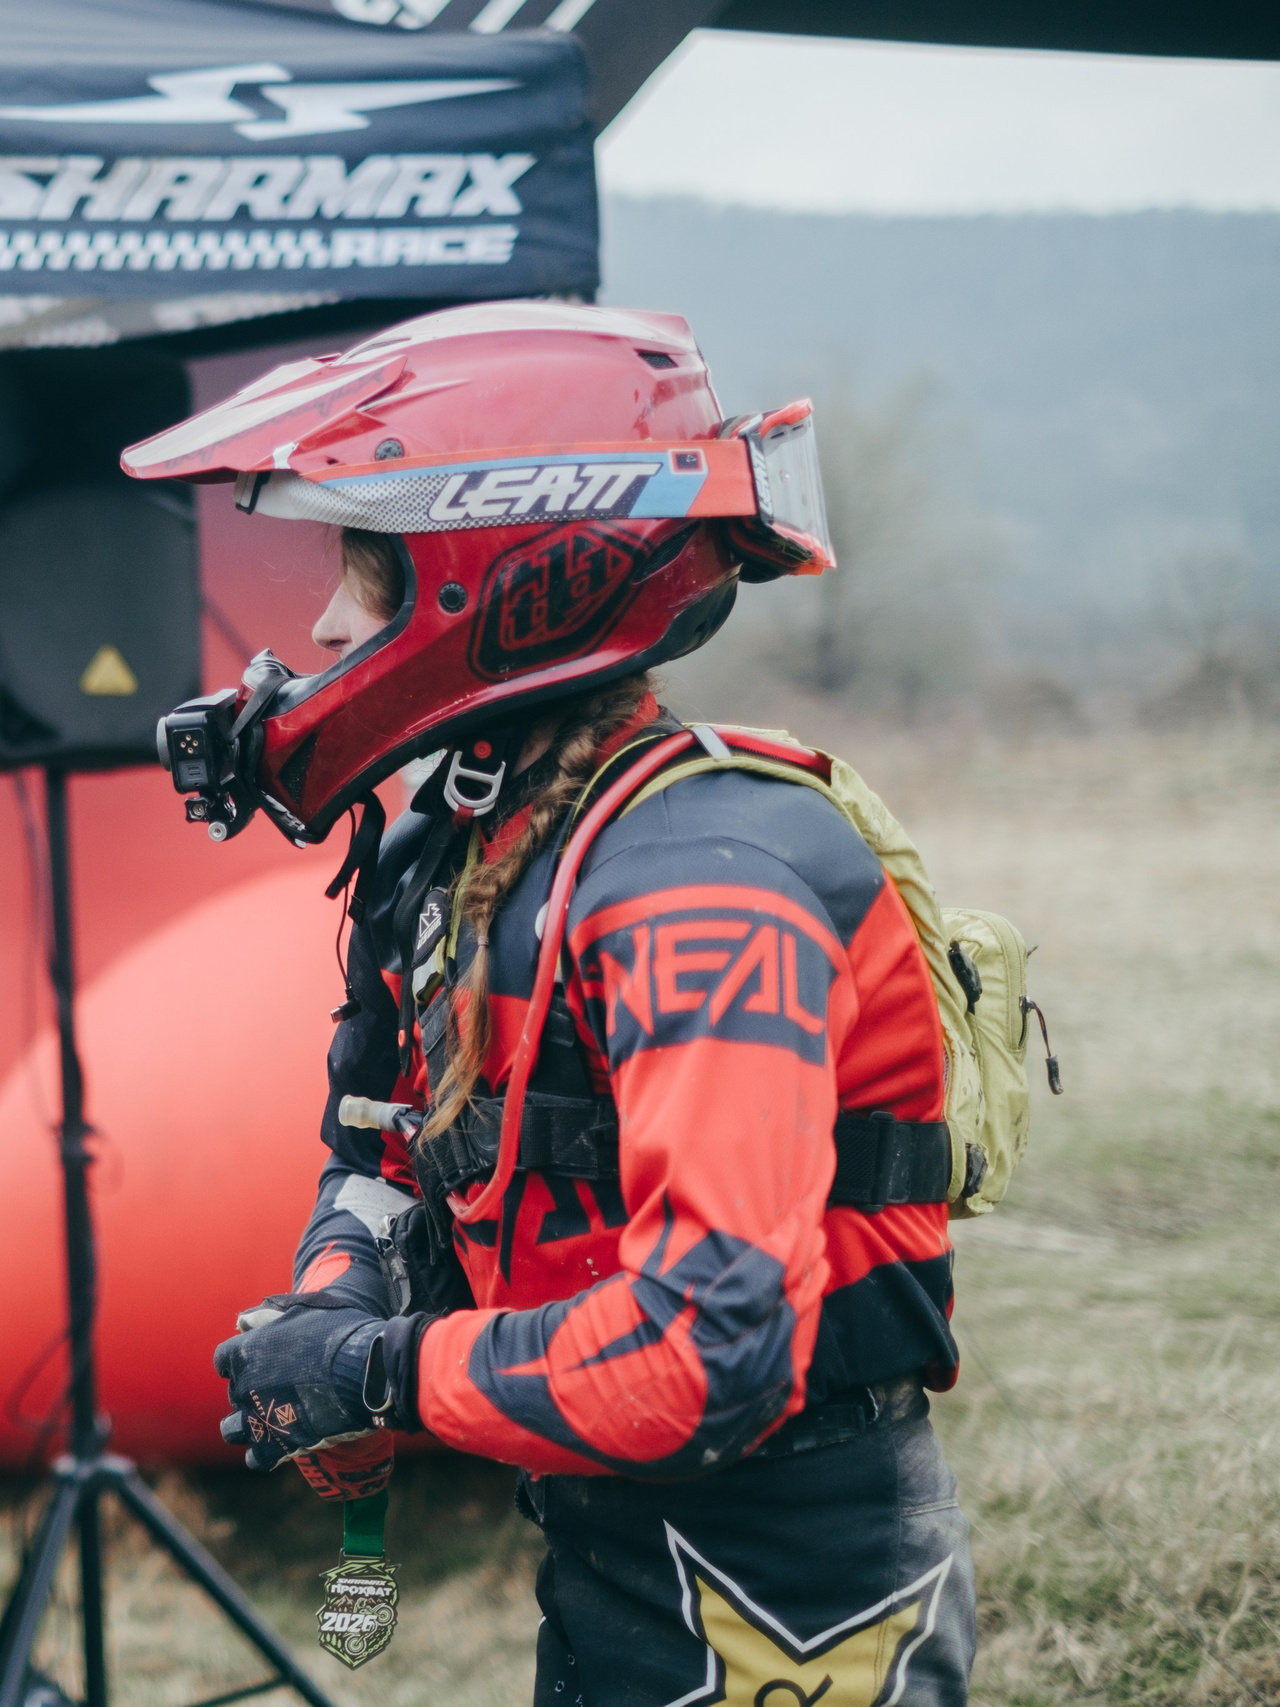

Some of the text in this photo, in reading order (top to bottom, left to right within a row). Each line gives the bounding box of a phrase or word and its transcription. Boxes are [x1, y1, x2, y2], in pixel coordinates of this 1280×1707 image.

[329, 225, 520, 268] RACE
[428, 462, 664, 521] LEATT
[582, 919, 826, 1037] NEAL
[249, 1389, 266, 1416] LEATT
[330, 1583, 393, 1597] ПРОХВАТ
[320, 1611, 378, 1633] 2026
